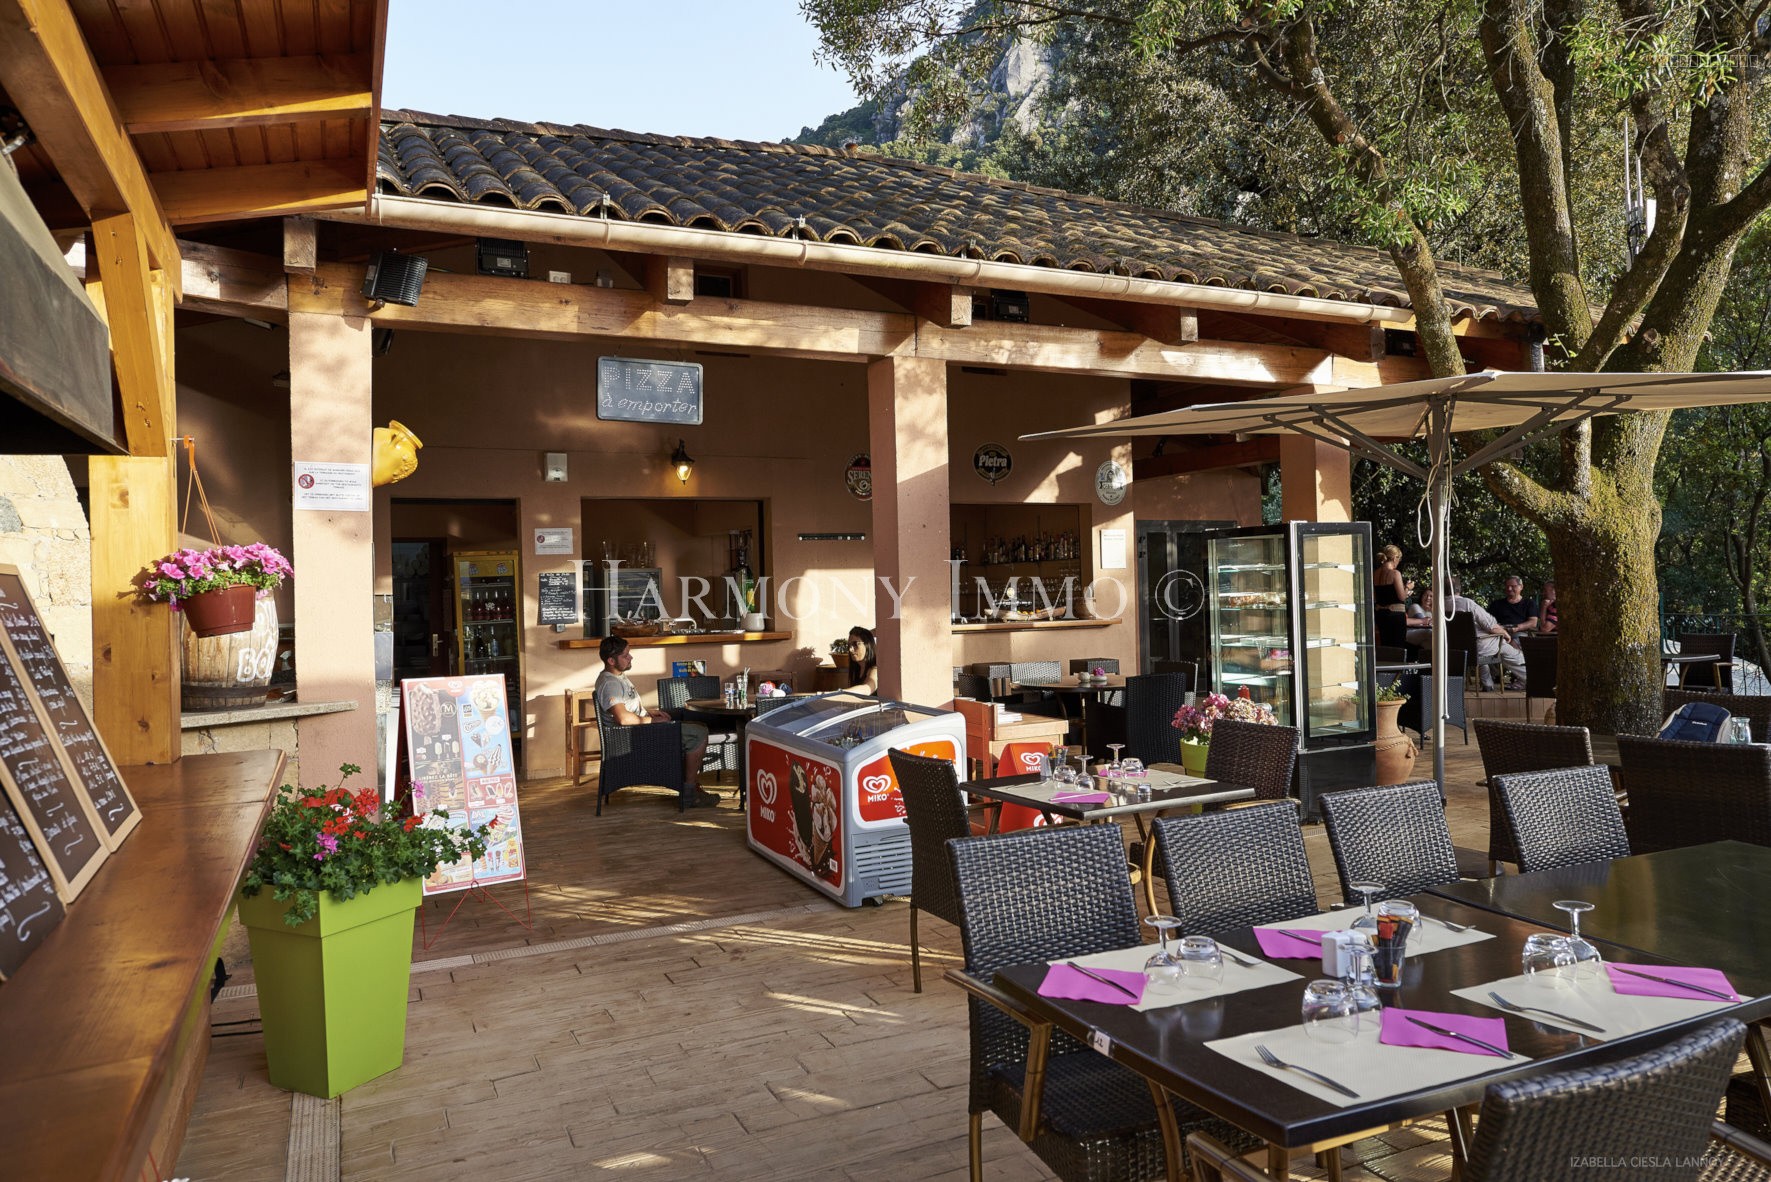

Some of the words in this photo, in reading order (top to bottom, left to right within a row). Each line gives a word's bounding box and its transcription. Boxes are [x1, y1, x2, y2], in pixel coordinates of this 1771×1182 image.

[603, 366, 695, 394] PIZZA
[601, 392, 613, 408] à
[617, 397, 697, 415] emporter
[979, 454, 1007, 467] Pietra
[847, 470, 872, 484] SEREN
[867, 793, 887, 803] MIKO
[760, 804, 775, 823] MIKO
